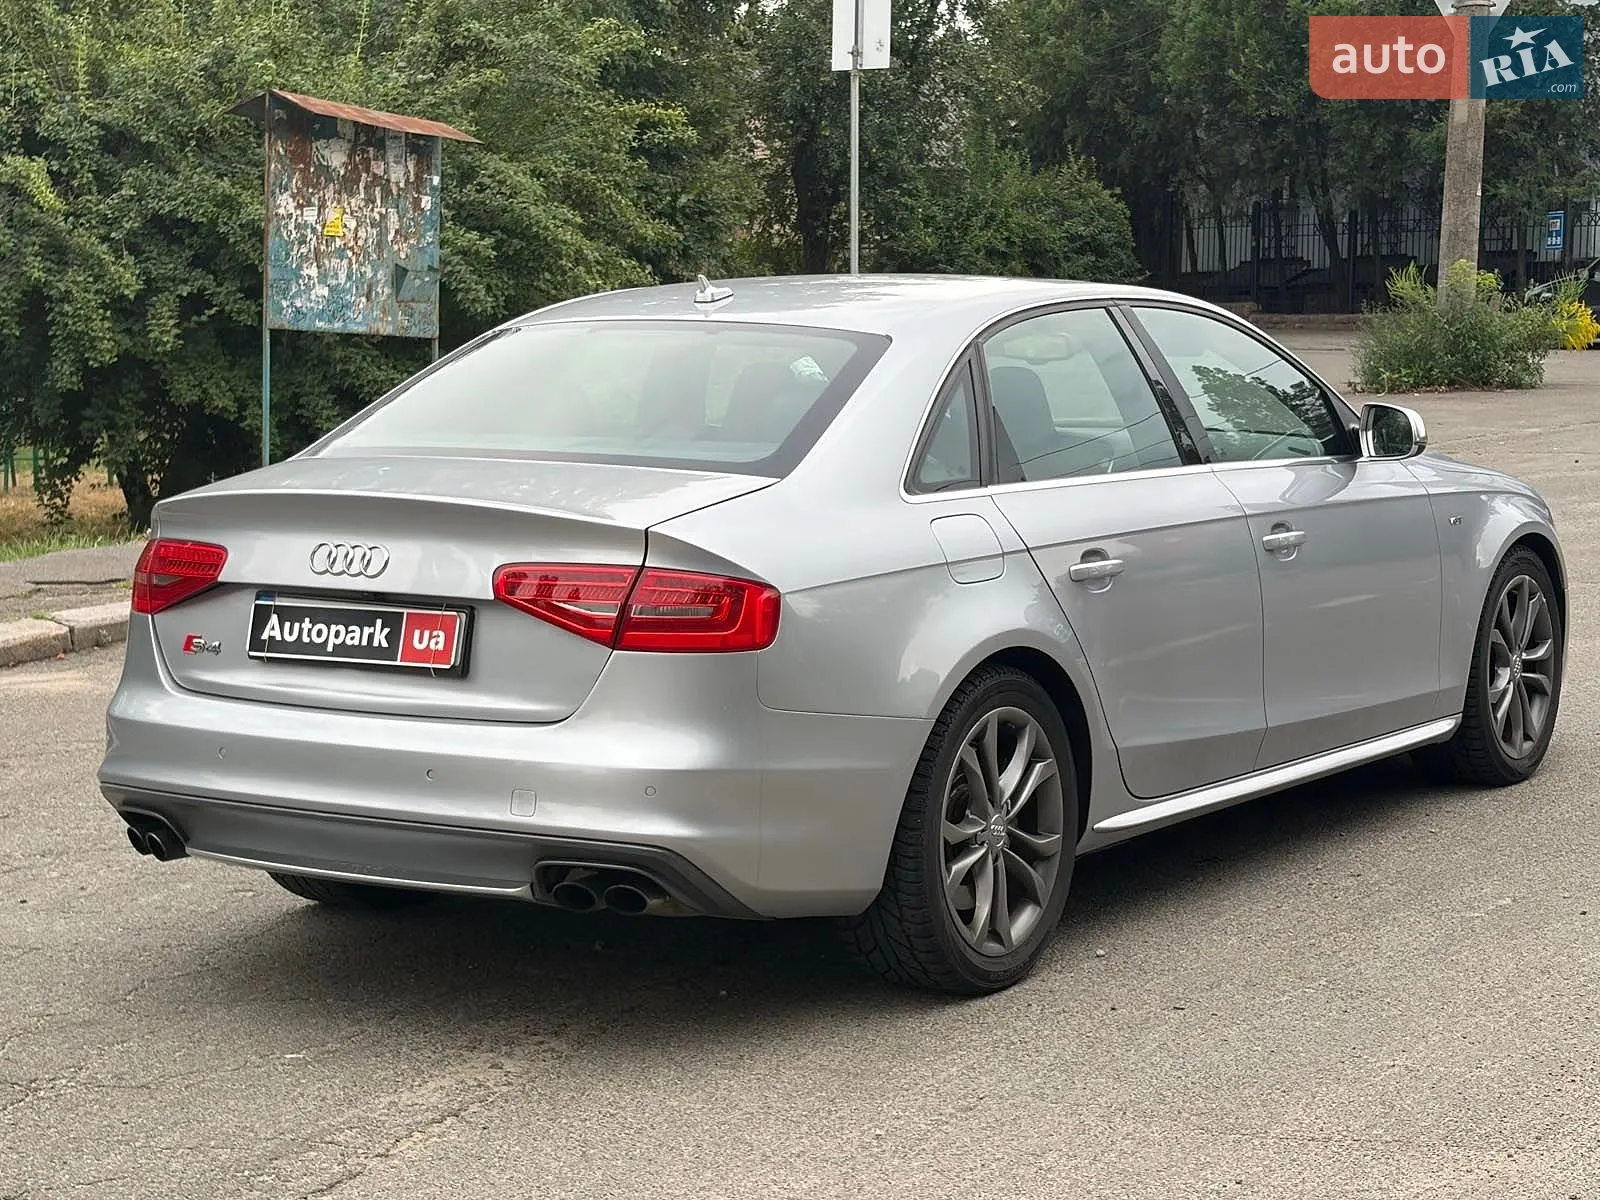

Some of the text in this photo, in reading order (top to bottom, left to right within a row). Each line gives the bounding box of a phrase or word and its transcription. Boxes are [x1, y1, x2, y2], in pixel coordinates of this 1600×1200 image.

[185, 634, 222, 656] S4
[261, 612, 446, 652] Autopark ua
